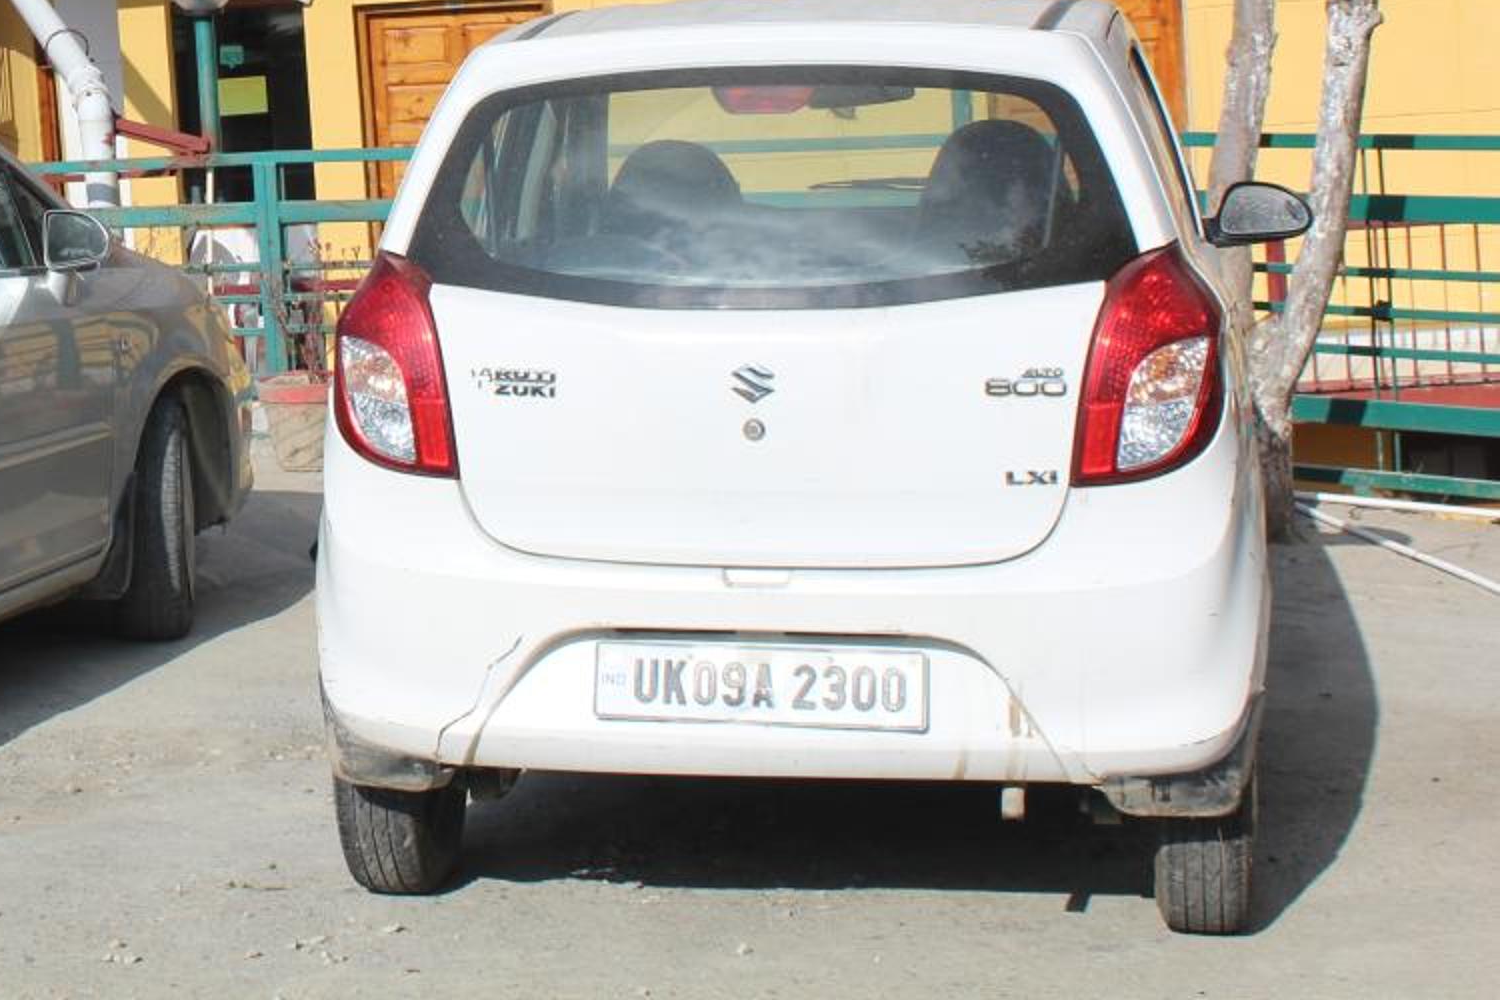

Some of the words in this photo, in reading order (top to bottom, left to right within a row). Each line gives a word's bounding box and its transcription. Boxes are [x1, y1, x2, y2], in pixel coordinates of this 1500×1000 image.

[984, 378, 1068, 397] 800
[633, 657, 775, 709] UK09A
[791, 662, 908, 713] 2300
